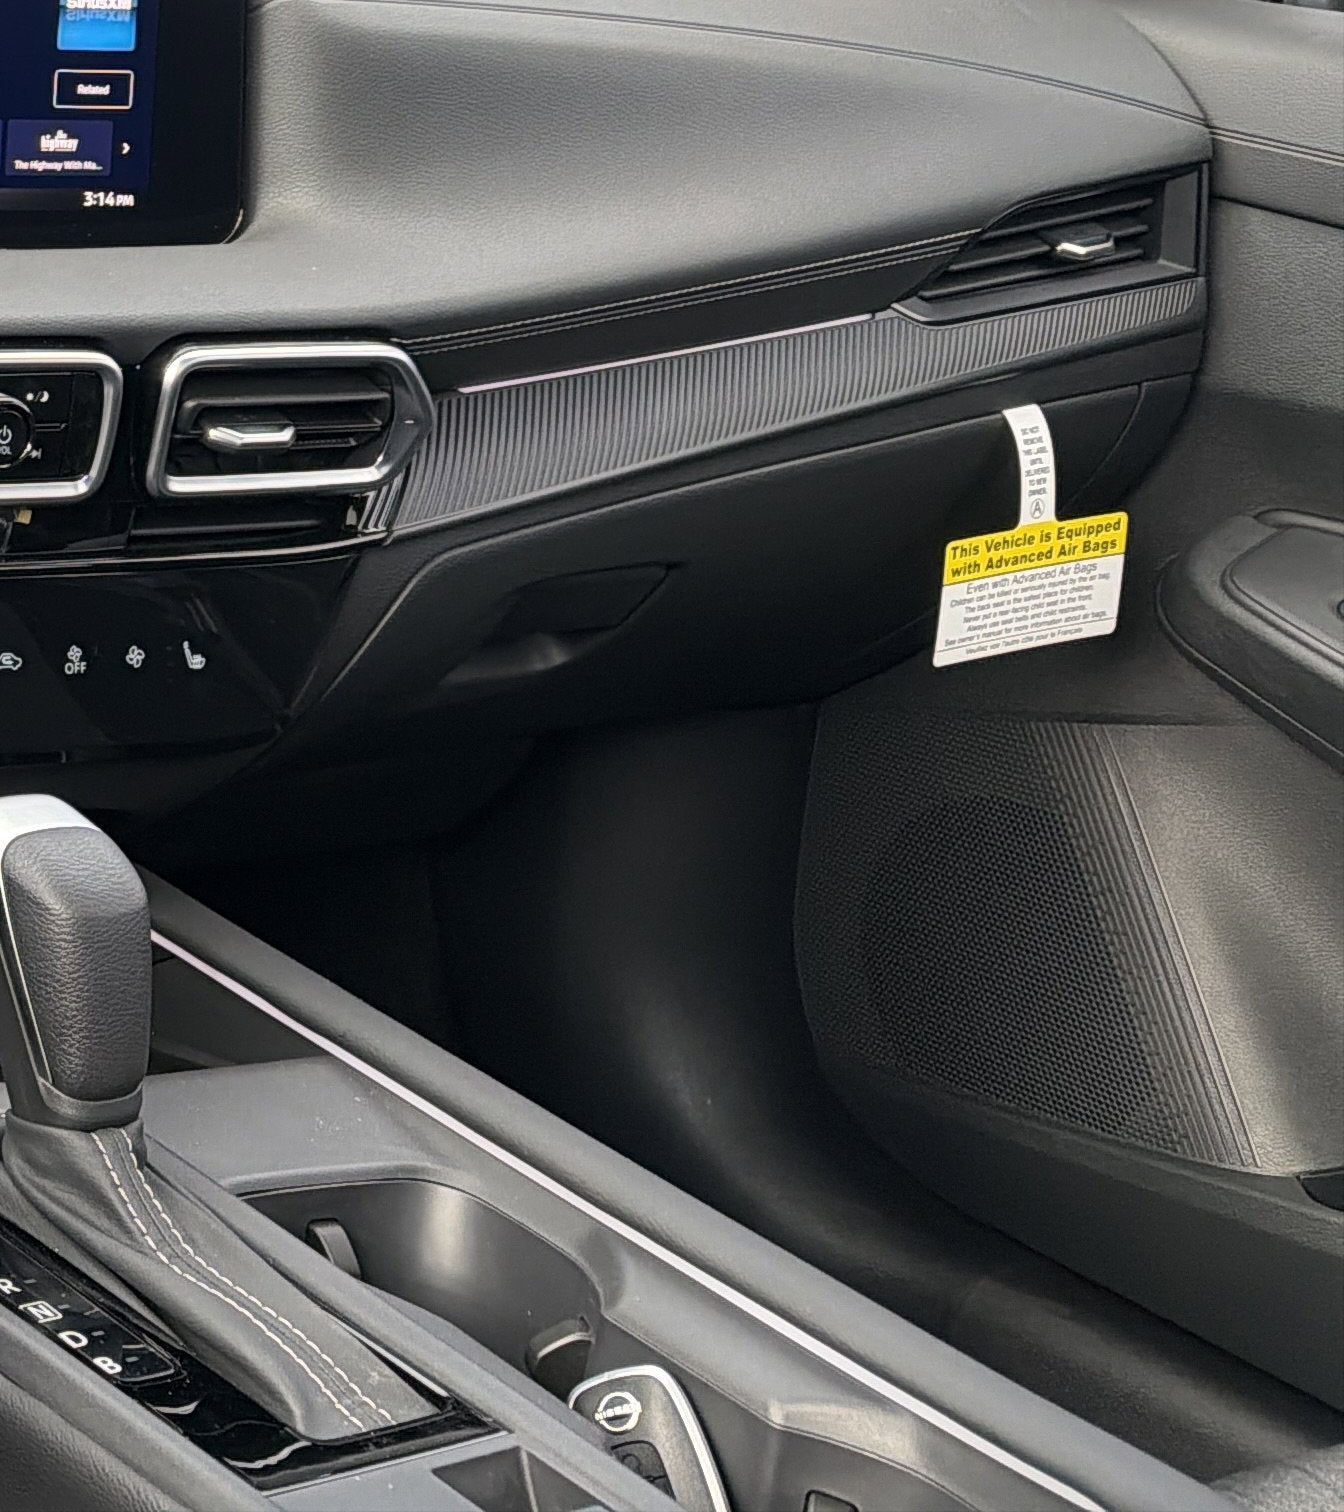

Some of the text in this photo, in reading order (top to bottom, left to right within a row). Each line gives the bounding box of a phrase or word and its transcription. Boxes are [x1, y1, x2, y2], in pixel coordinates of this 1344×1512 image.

[77, 84, 110, 95] Related
[30, 160, 63, 171] Highway
[83, 192, 134, 207] 3:14 PM
[951, 518, 1121, 560] This Vehicle is Equipped
[951, 538, 1117, 577] with Advanced Air Bags
[967, 583, 989, 594] Even
[992, 578, 1009, 589] with
[1012, 568, 1056, 584] Advanced
[1074, 563, 1097, 574] Bags
[64, 662, 87, 675] OFF
[31, 1305, 52, 1319] N
[58, 1331, 89, 1348] D
[92, 1356, 122, 1374] B
